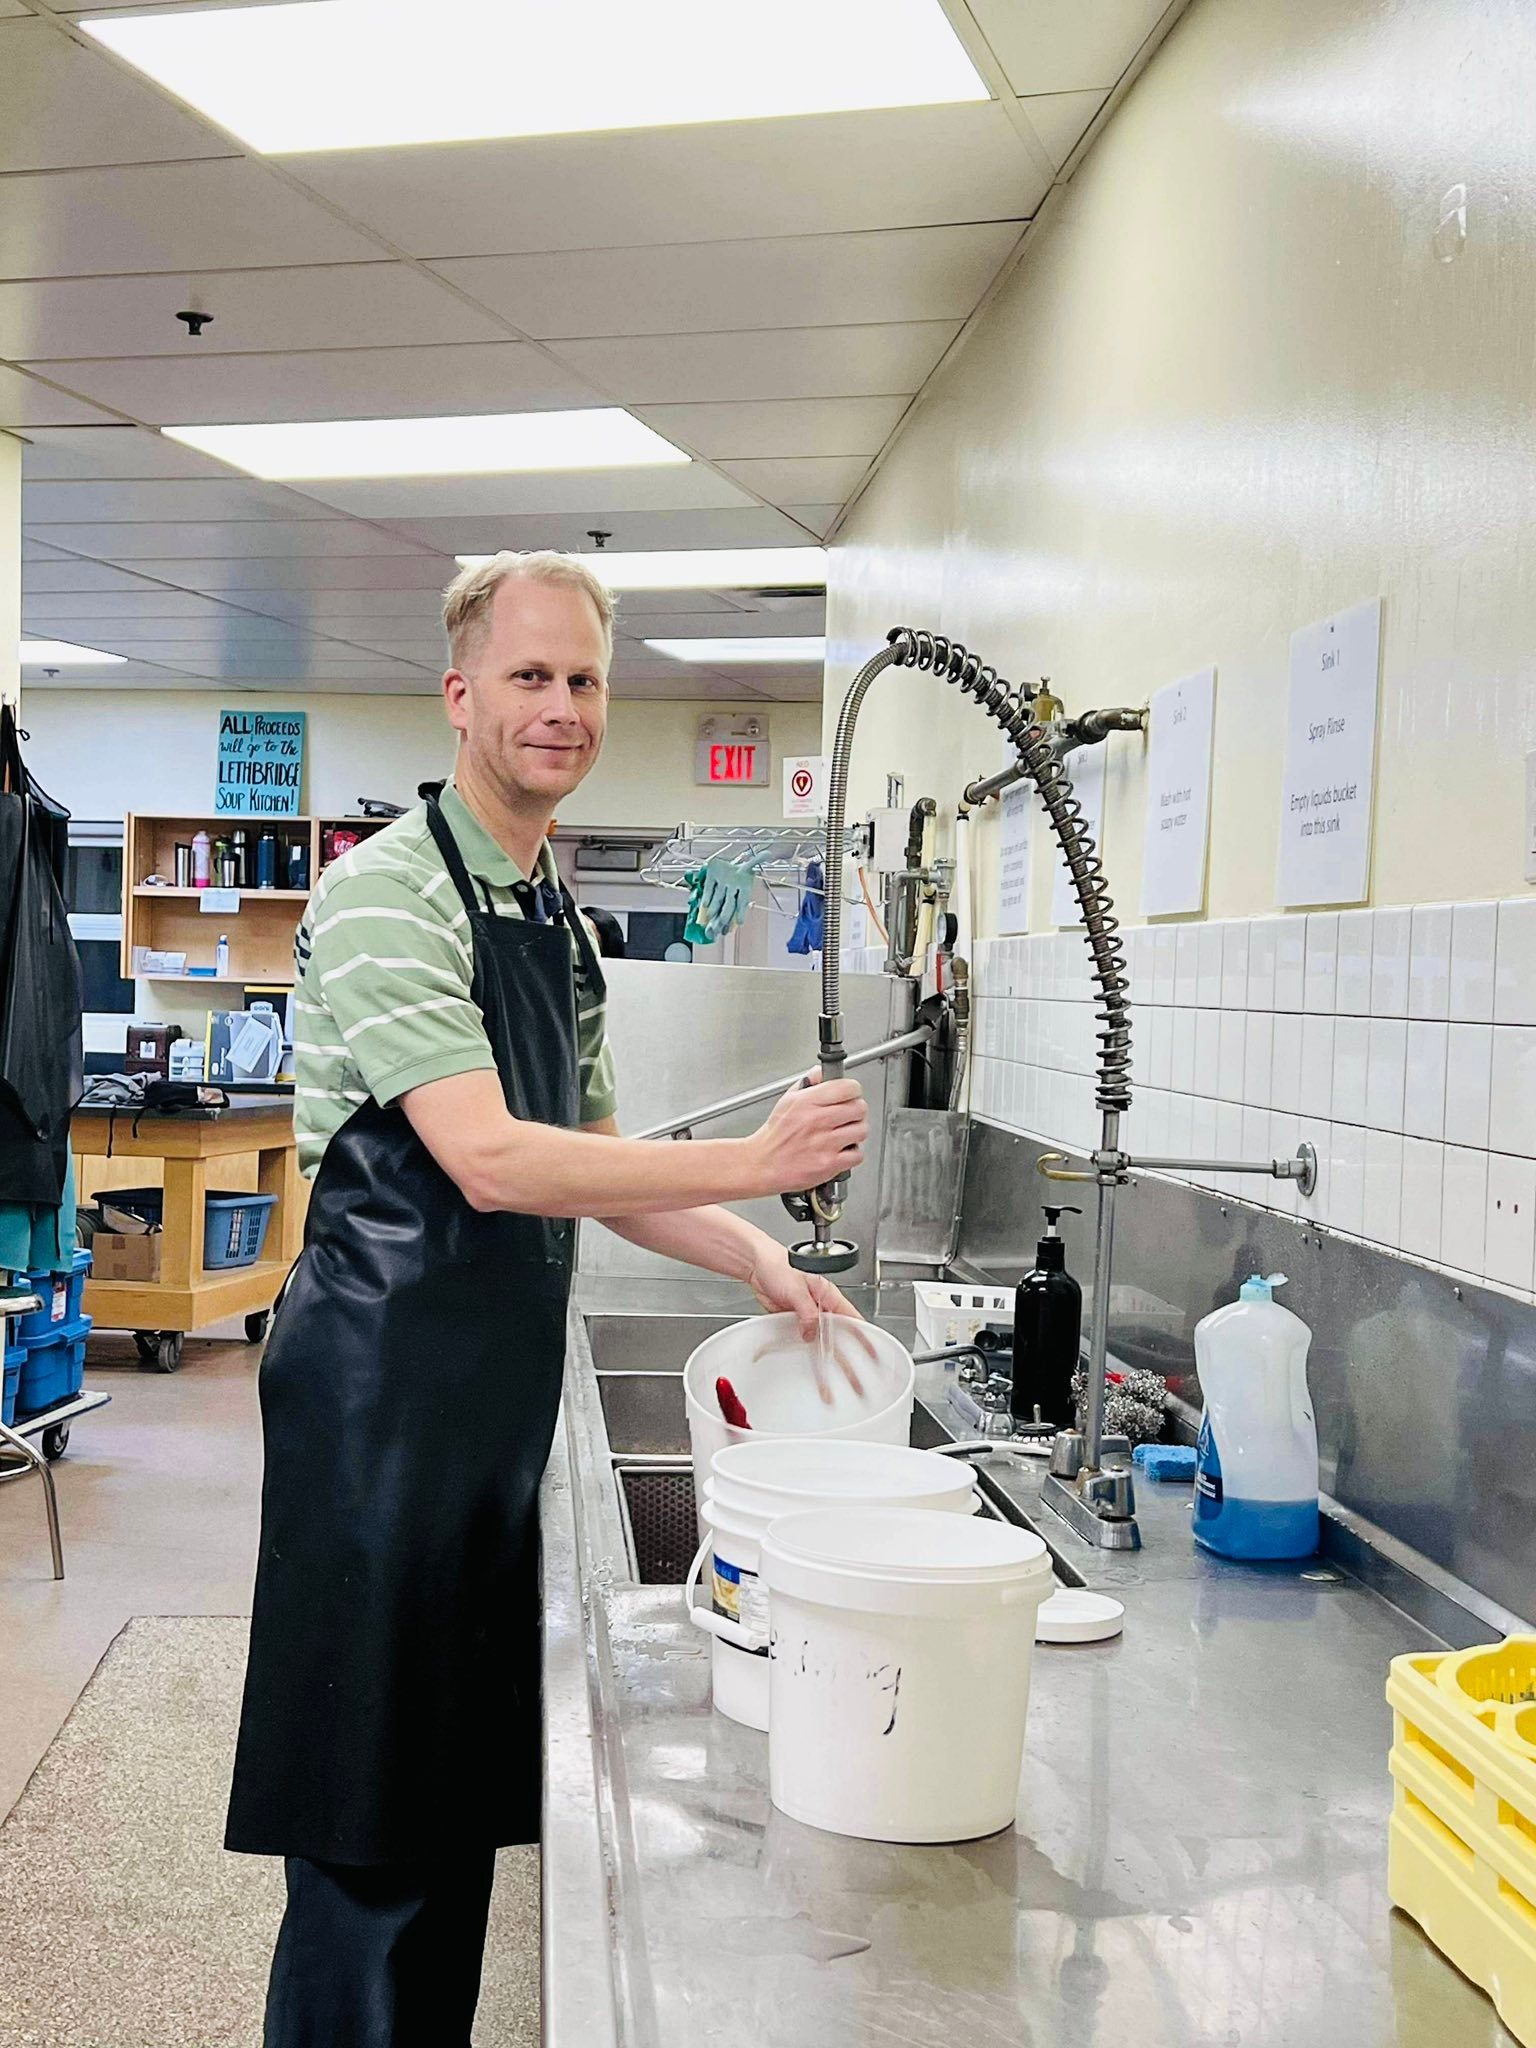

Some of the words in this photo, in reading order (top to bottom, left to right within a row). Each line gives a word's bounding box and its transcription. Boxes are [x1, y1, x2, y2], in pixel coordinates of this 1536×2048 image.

[1321, 649, 1335, 671] Sink
[220, 715, 252, 735] ALL
[255, 714, 301, 736] PROCEEDS
[1309, 722, 1326, 743] Spray
[1327, 717, 1345, 735] Rinse
[220, 738, 244, 754] will
[247, 743, 261, 758] go
[264, 739, 279, 752] to
[219, 760, 300, 787] LETHBRIDGE
[710, 744, 756, 782] EXIT
[216, 786, 246, 811] SOUP
[249, 787, 295, 812] KITCHEN!
[1290, 793, 1309, 813] Empty
[1311, 787, 1331, 811] liquids
[1333, 781, 1358, 802] bucket
[1300, 820, 1312, 837] into
[1313, 816, 1325, 835] this
[1326, 813, 1340, 833] sink
